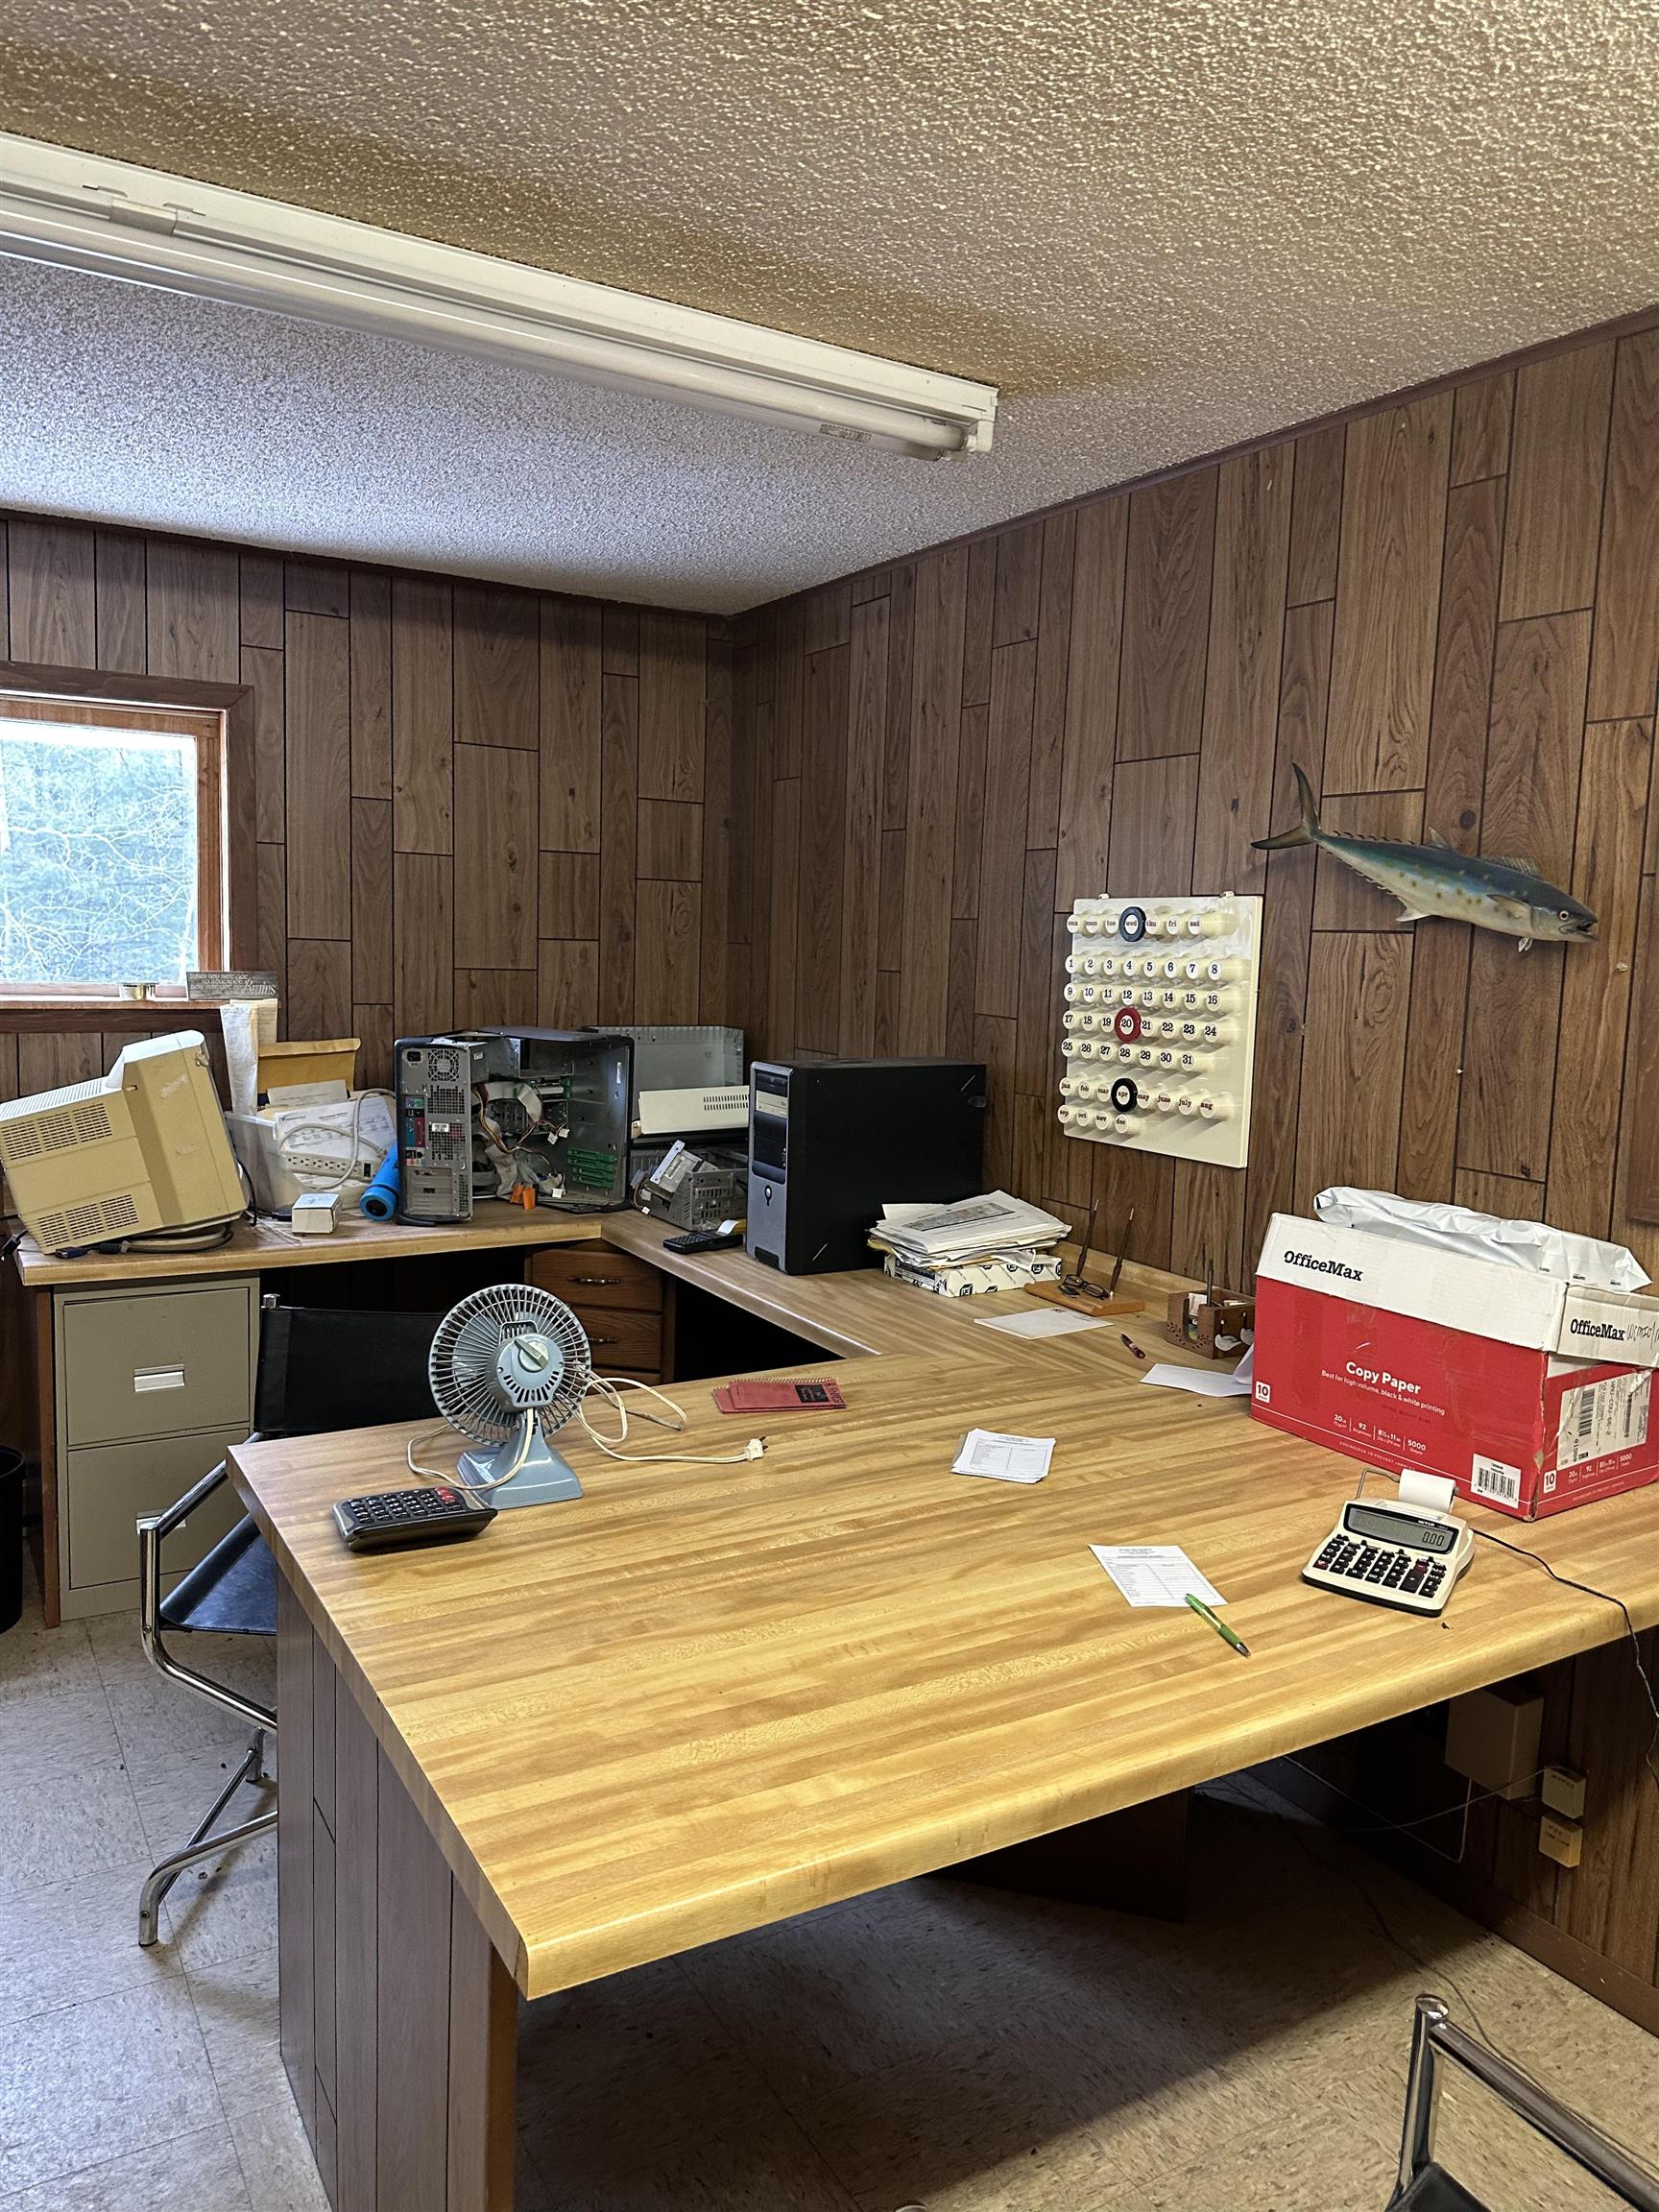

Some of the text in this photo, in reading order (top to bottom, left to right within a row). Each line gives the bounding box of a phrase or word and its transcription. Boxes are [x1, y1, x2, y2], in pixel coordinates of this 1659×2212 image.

[1146, 919, 1157, 927] thu
[1167, 919, 1177, 927] fri
[1069, 959, 1218, 974] 1 2 3 4 5 6 7 8
[1068, 987, 1218, 1005] 9 10 11 12 13 14 15 16
[1065, 1014, 1217, 1036] 17 18 19 20 21 22 23 24
[1063, 1042, 1192, 1065] 25 26 27 28 29 30 31
[1061, 1081, 1070, 1090] jan
[1080, 1084, 1090, 1093] feb
[1137, 1094, 1149, 1102] may
[1157, 1094, 1171, 1103] june
[1178, 1098, 1191, 1108] july
[1200, 1102, 1214, 1111] aug
[1116, 1117, 1125, 1125] dec
[1284, 1249, 1363, 1282] OfficeMax
[1571, 1319, 1625, 1340] OfficeMax
[1345, 1361, 1422, 1397] Copy Paper
[1258, 1384, 1268, 1396] 10
[1321, 1370, 1334, 1381] Best
[1334, 1373, 1344, 1382] for
[1343, 1376, 1358, 1387] high
[1358, 1382, 1381, 1396] volume,
[1381, 1388, 1397, 1400] black
[1403, 1395, 1420, 1407] white
[1420, 1402, 1445, 1415] printing
[1358, 1422, 1367, 1431] 92
[1407, 1439, 1427, 1451] 5000
[1546, 1473, 1555, 1486] 10
